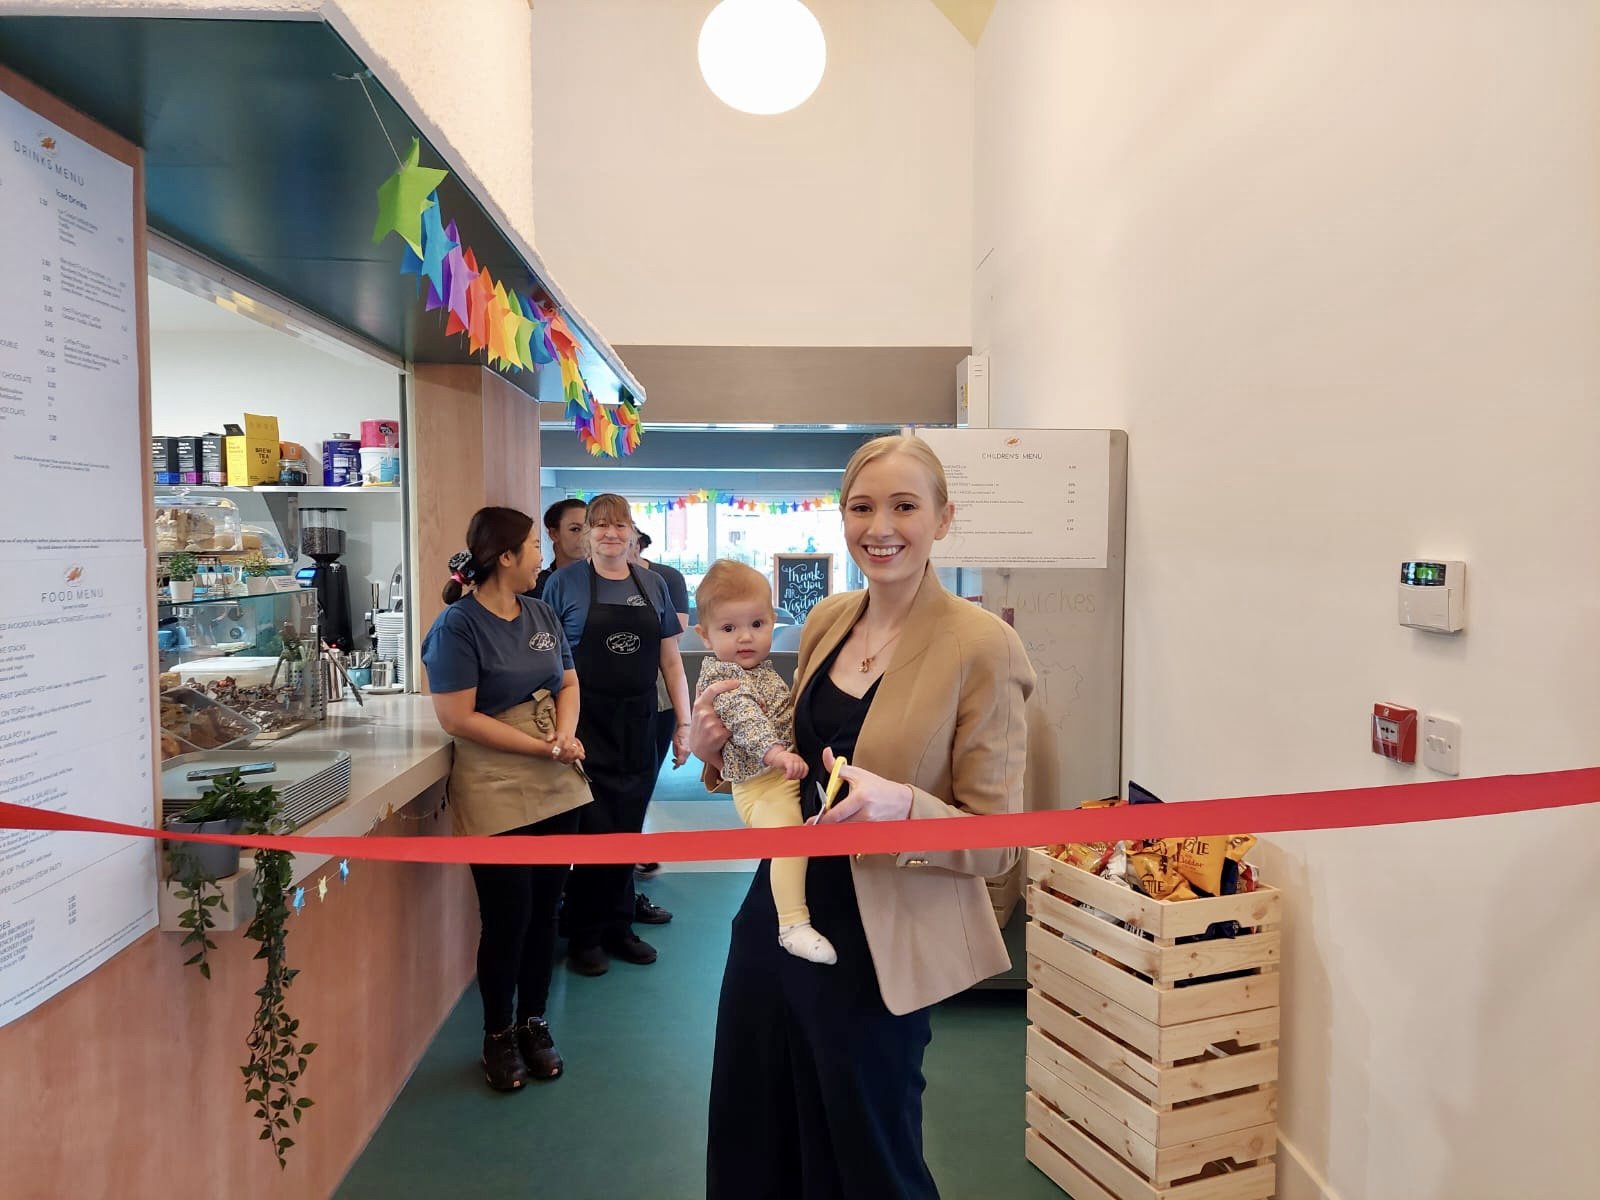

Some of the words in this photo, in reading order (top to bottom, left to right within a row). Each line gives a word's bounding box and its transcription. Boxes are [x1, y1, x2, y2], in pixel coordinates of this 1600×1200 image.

[14, 140, 53, 170] DRINKS
[55, 163, 85, 186] MENU
[781, 562, 824, 583] Thank
[41, 591, 73, 603] FOOD
[76, 588, 104, 600] MENU
